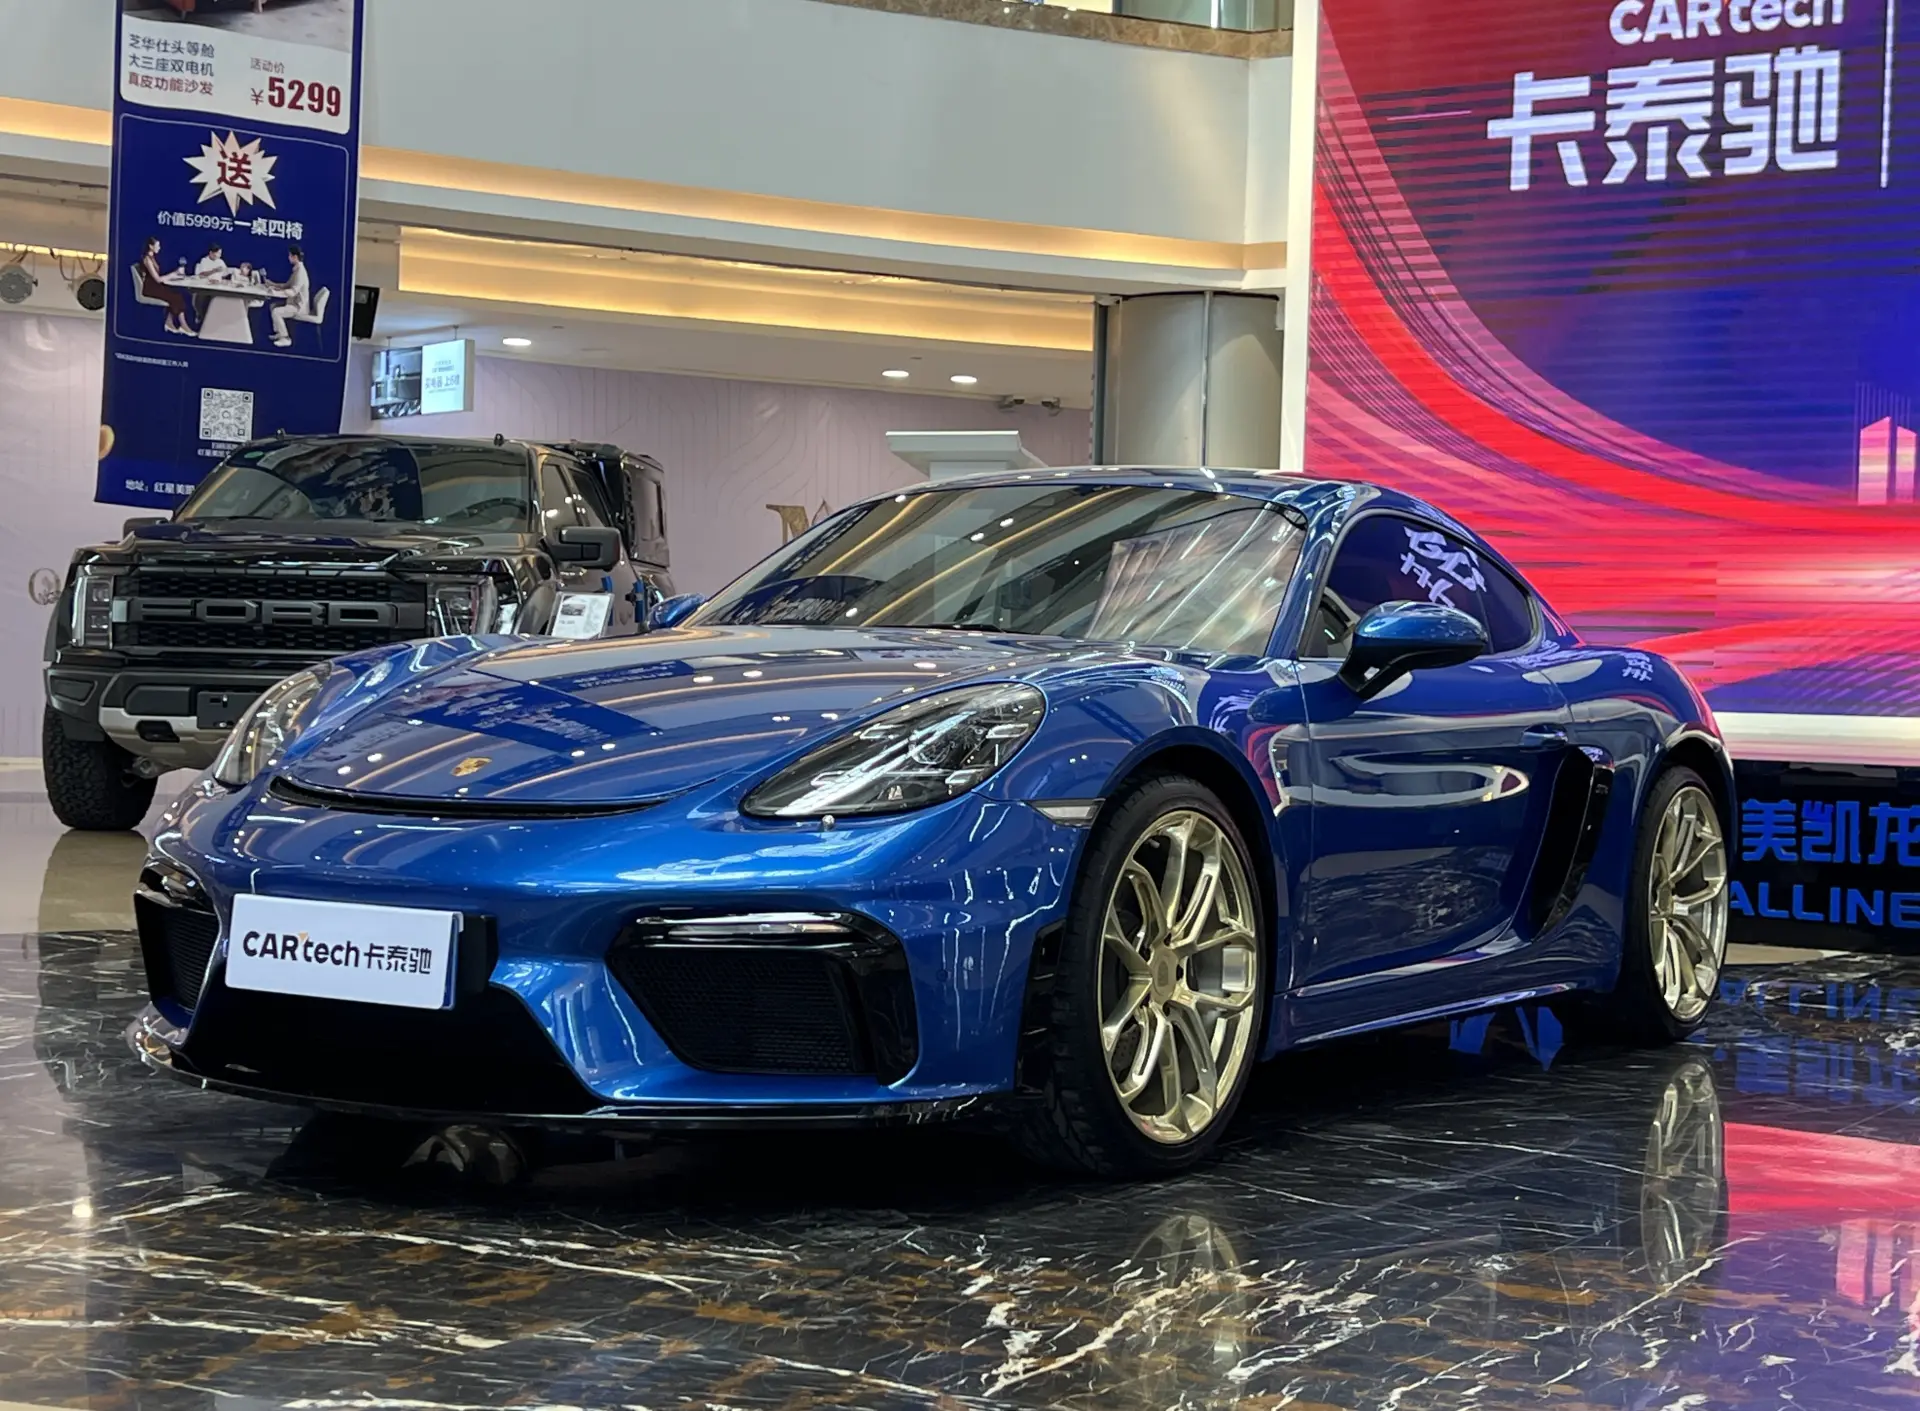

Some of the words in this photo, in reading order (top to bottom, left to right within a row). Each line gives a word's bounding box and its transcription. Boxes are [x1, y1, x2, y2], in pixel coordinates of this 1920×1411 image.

[129, 33, 214, 58] 芝华仕头等舱
[129, 53, 214, 77] 大三座双电机
[250, 57, 285, 74] 活动价
[128, 71, 213, 96] 真皮功能沙发
[1487, 45, 1841, 191] 卡泰驰
[217, 150, 252, 189] 送
[157, 211, 303, 240] 价值5999元一桌四椅
[129, 598, 399, 628] FORD
[1742, 798, 1920, 867] 美凯龙
[242, 930, 360, 967] CARtech
[363, 942, 432, 975] 卡泰驰
